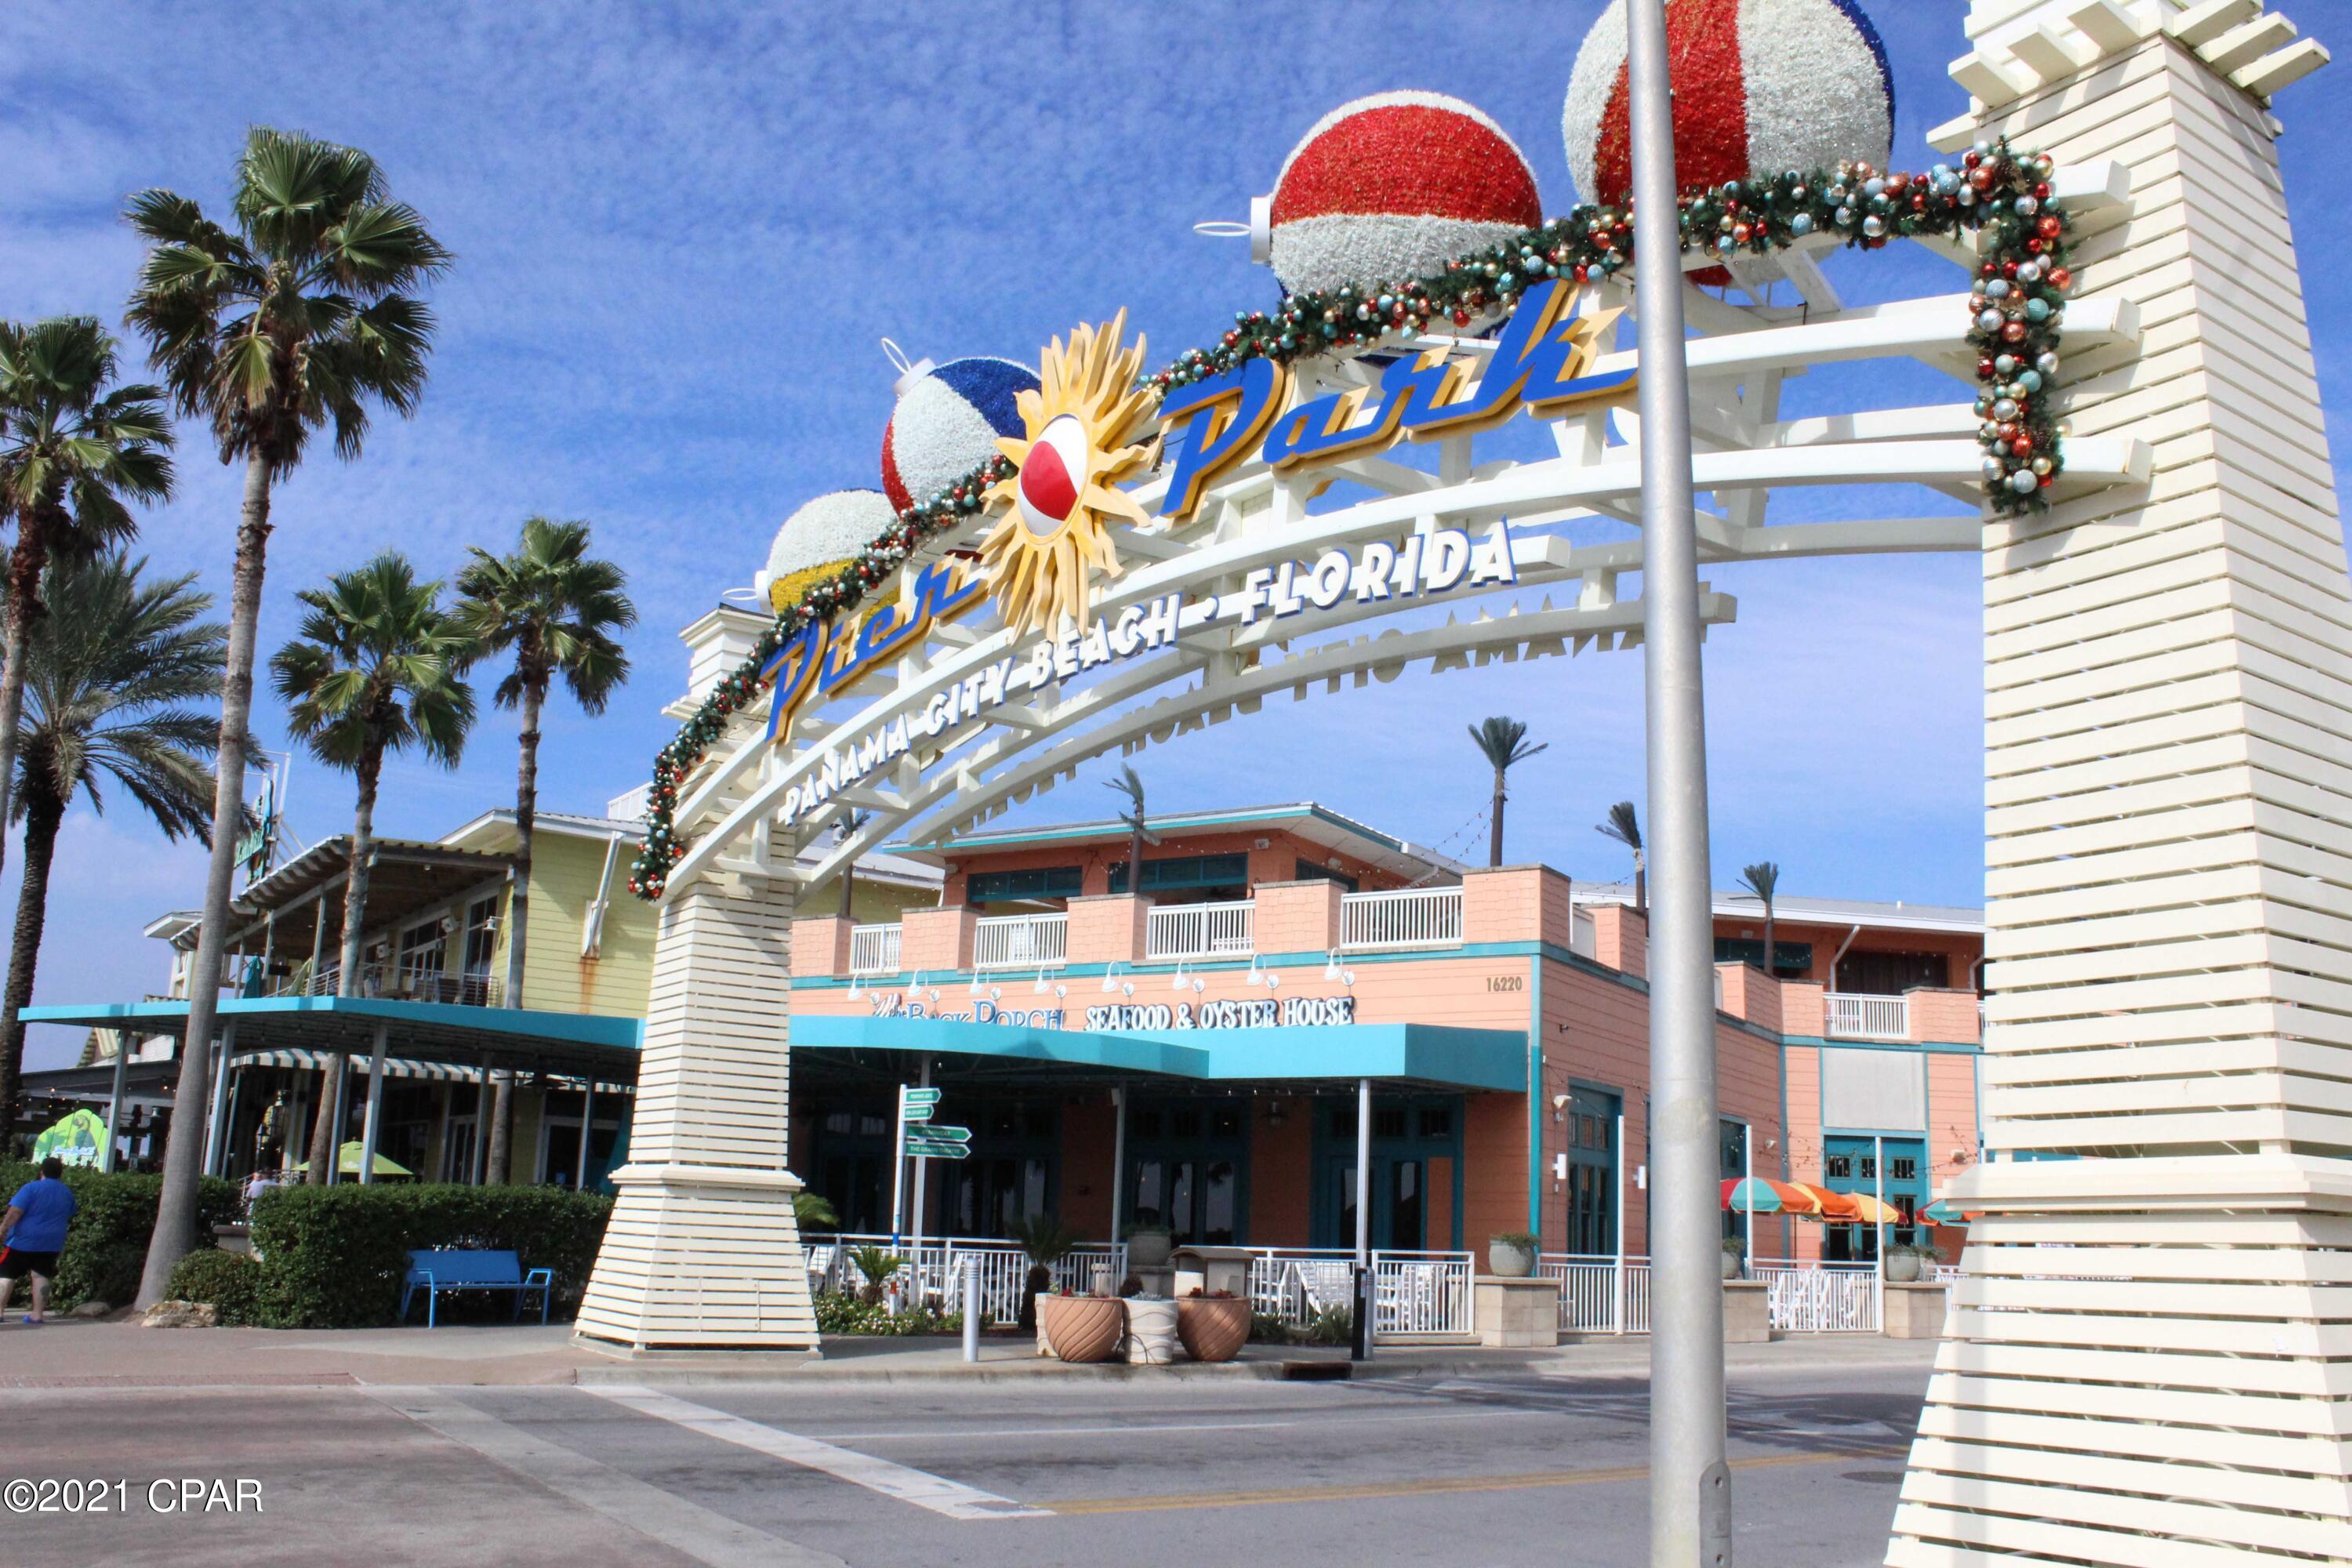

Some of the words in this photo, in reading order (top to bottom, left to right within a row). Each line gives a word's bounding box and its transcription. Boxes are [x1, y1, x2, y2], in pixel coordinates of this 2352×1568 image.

[1159, 279, 1638, 521] Park
[777, 713, 910, 826] PANAMA
[925, 655, 1015, 737] CITY
[1029, 593, 1182, 691] BEACH
[1242, 514, 1516, 626] FLORIDA
[1085, 1004, 1171, 1031] SEAFOOD
[1176, 1004, 1196, 1029] &
[1200, 999, 1279, 1029] OYSTER
[1283, 996, 1353, 1026] HOUSE
[1486, 976, 1523, 992] 16220
